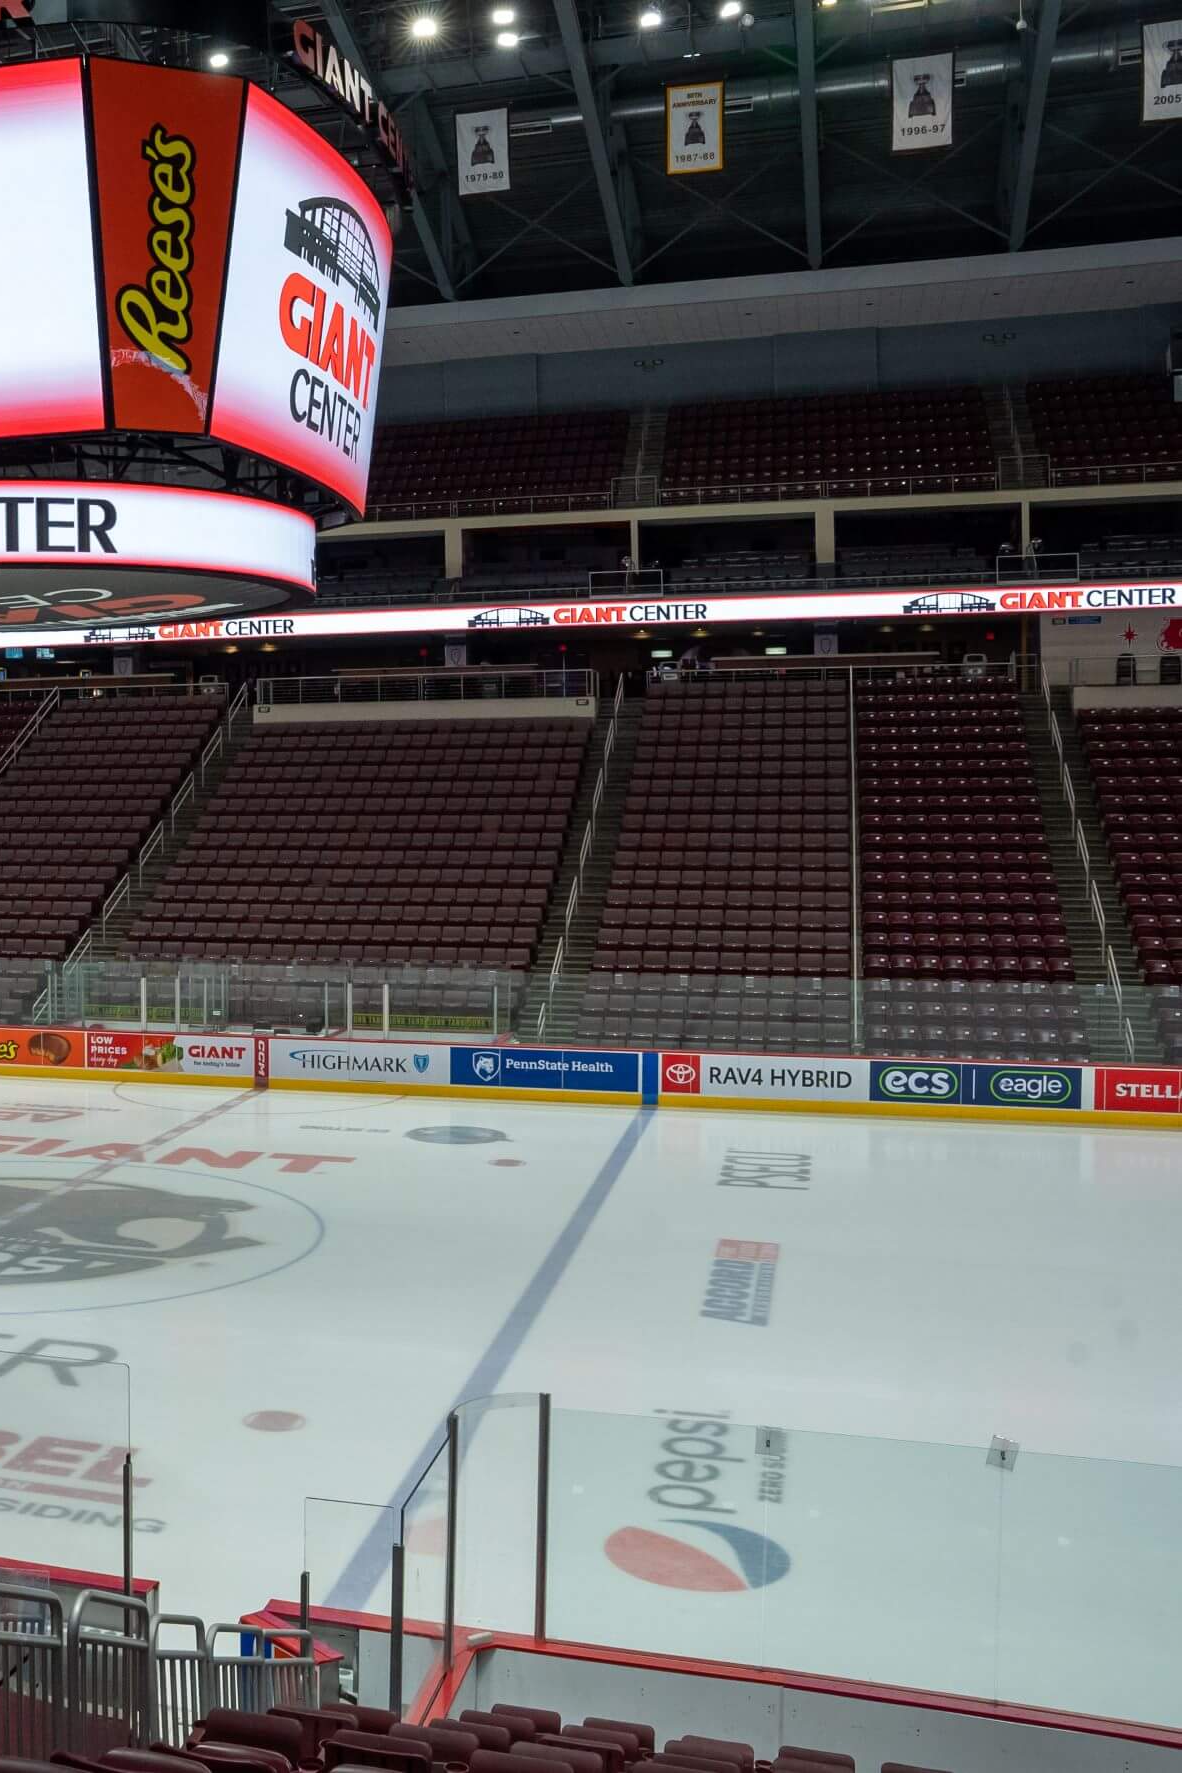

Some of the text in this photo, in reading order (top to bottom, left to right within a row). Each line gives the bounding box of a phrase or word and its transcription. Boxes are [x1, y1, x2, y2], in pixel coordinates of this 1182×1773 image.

[293, 19, 373, 123] GIANT
[900, 124, 946, 137] 1996-97
[464, 171, 504, 183] 1979-80
[119, 126, 194, 371] Reese's
[279, 272, 376, 412] GIANT
[290, 368, 362, 464] CENTER
[1000, 588, 1176, 610] GIANT CENTER
[554, 603, 707, 624] GIANT CENTER
[159, 619, 294, 638] GIANT CENTER
[90, 1036, 113, 1045] LOW
[90, 1045, 128, 1055] PRICES
[188, 1045, 246, 1060] GIANT
[258, 1040, 266, 1076] CCM
[301, 1050, 407, 1073] HIGHMARK
[572, 1059, 614, 1073] Health
[709, 1066, 852, 1089] RAV4 HYBRID
[884, 1070, 950, 1095] ecs
[999, 1074, 1064, 1099] eagle
[647, 1408, 748, 1515] pepsi
